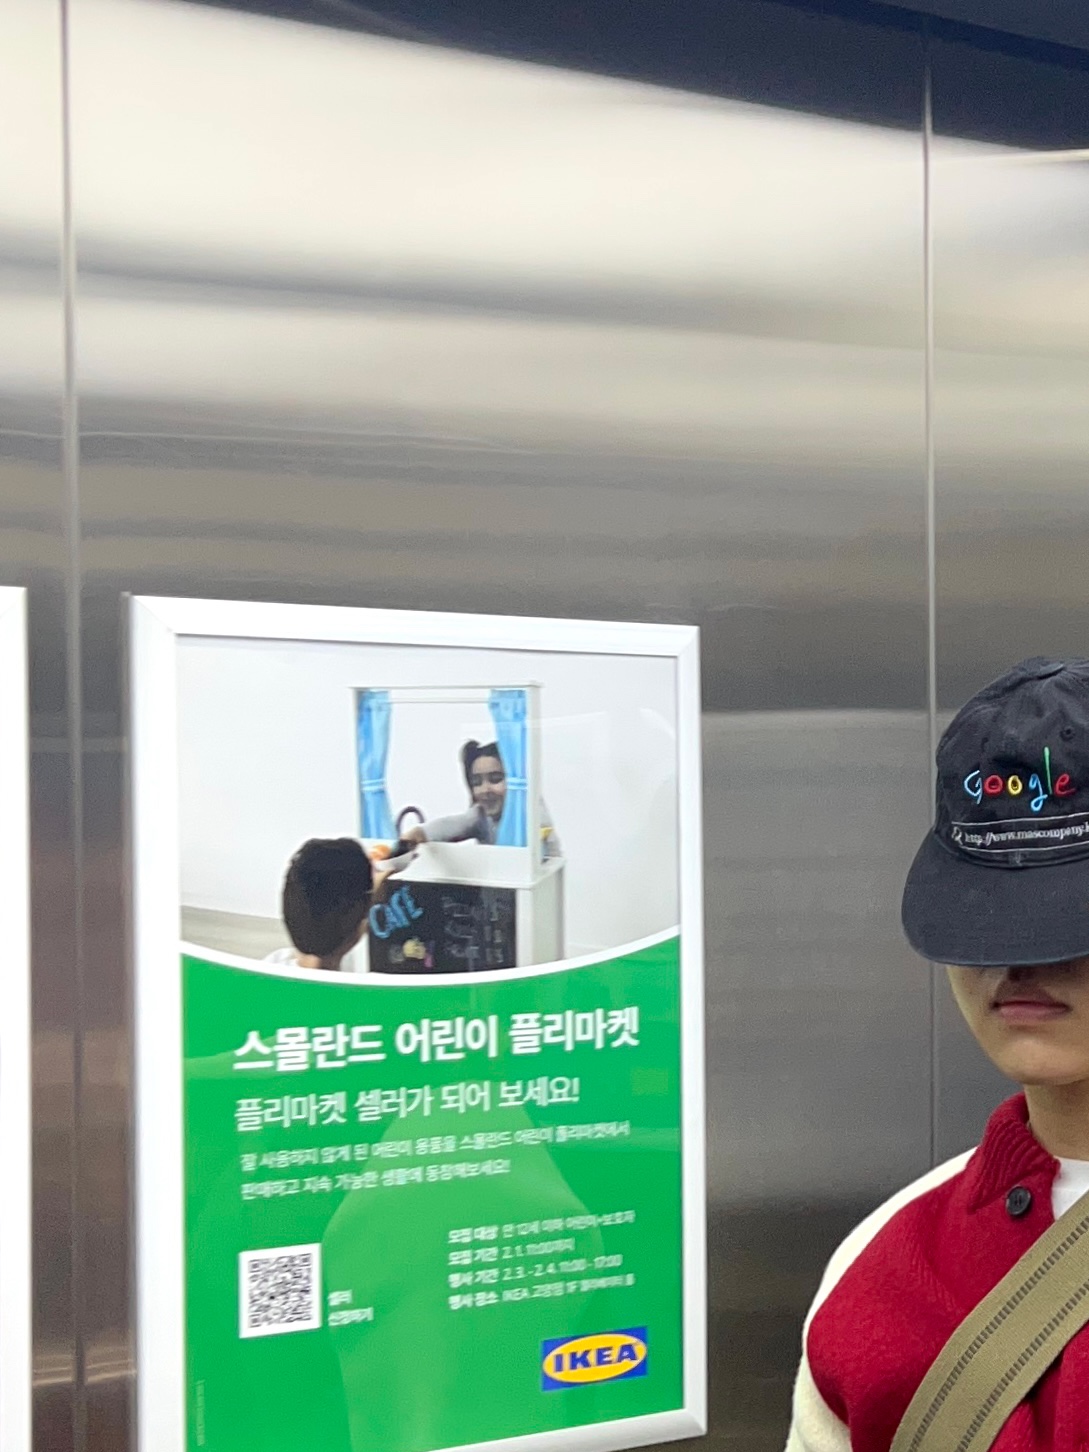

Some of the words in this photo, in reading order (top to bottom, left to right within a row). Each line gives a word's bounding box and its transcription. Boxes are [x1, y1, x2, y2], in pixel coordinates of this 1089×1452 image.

[963, 747, 1077, 812] Google
[233, 1023, 387, 1072] 스몰란드
[395, 1015, 499, 1063] 어린이
[508, 1006, 641, 1055] 플리마켓
[234, 1091, 348, 1132] 플리마켓
[354, 1085, 435, 1122] 셀러가
[440, 1080, 491, 1114] 되어
[498, 1076, 581, 1107] 보세요!
[259, 1147, 319, 1169] 사용하지
[371, 1138, 413, 1158] 어린이
[458, 1131, 513, 1151] 스몰란드
[553, 1343, 638, 1374] IKEA
